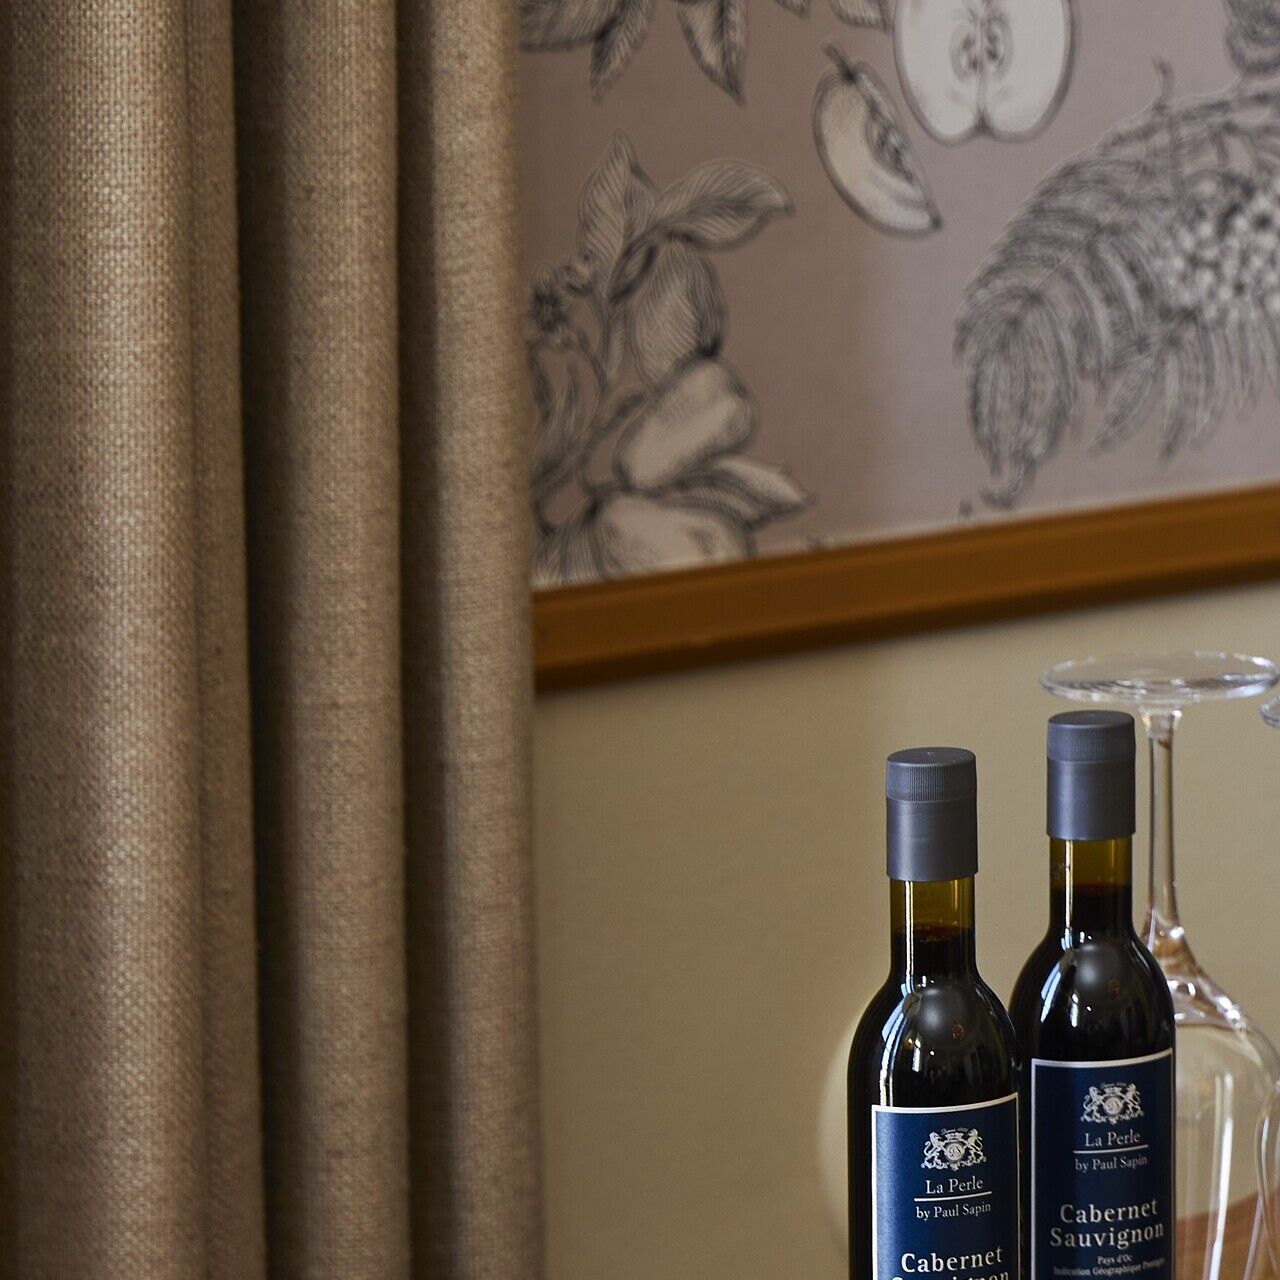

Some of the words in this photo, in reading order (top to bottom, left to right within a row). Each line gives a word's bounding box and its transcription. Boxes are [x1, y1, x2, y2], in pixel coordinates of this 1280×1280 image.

[1085, 1133, 1101, 1146] La
[1107, 1129, 1140, 1145] Perle
[1075, 1159, 1088, 1172] by
[1093, 1157, 1117, 1170] Paul
[1120, 1155, 1147, 1169] Sapin
[925, 1180, 943, 1194] La
[949, 1176, 983, 1192] Perle
[916, 1206, 930, 1220] by
[934, 1204, 959, 1218] Paul
[962, 1201, 991, 1216] Sapin
[1060, 1198, 1157, 1223] Cabernet
[1050, 1223, 1163, 1249] Sauvignon
[901, 1246, 1002, 1272] Cabernet
